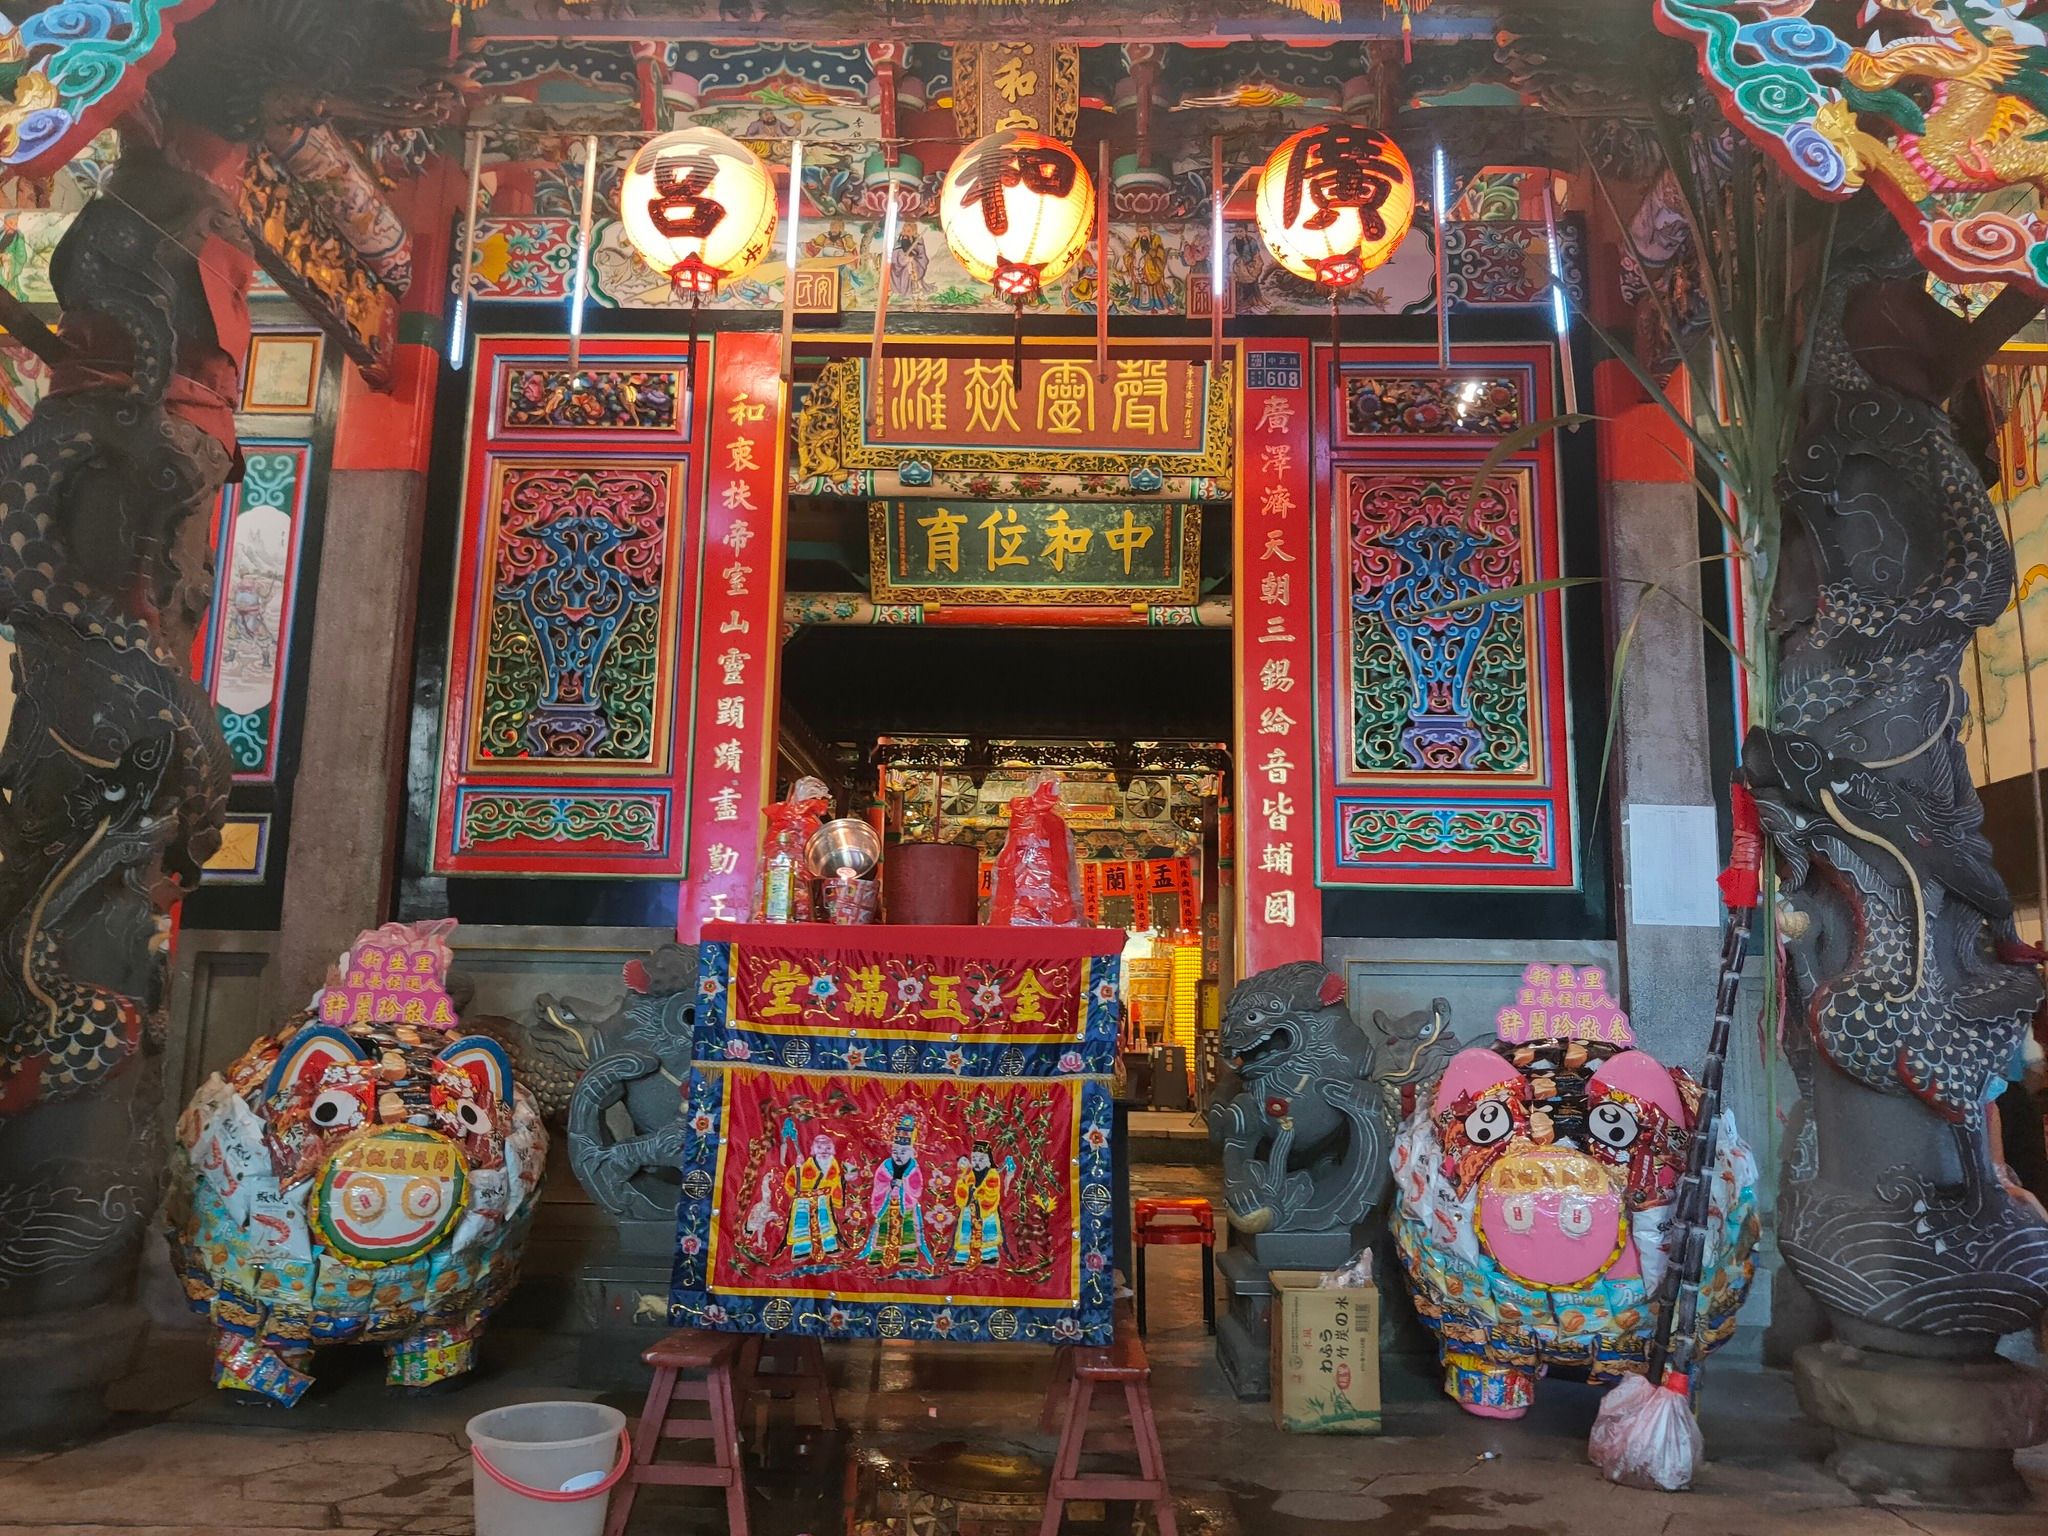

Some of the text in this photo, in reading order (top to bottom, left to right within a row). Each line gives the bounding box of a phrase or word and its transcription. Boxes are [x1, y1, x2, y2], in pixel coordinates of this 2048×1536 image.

[955, 132, 1077, 237] 和
[1283, 123, 1404, 242] 廣
[1267, 371, 1298, 387] 608
[359, 949, 434, 973] 新生里
[349, 971, 442, 993] 里長候選人
[1528, 967, 1603, 989] 新生里
[1520, 989, 1615, 1009] 里長候選人
[1318, 1328, 1333, 1374] わふう
